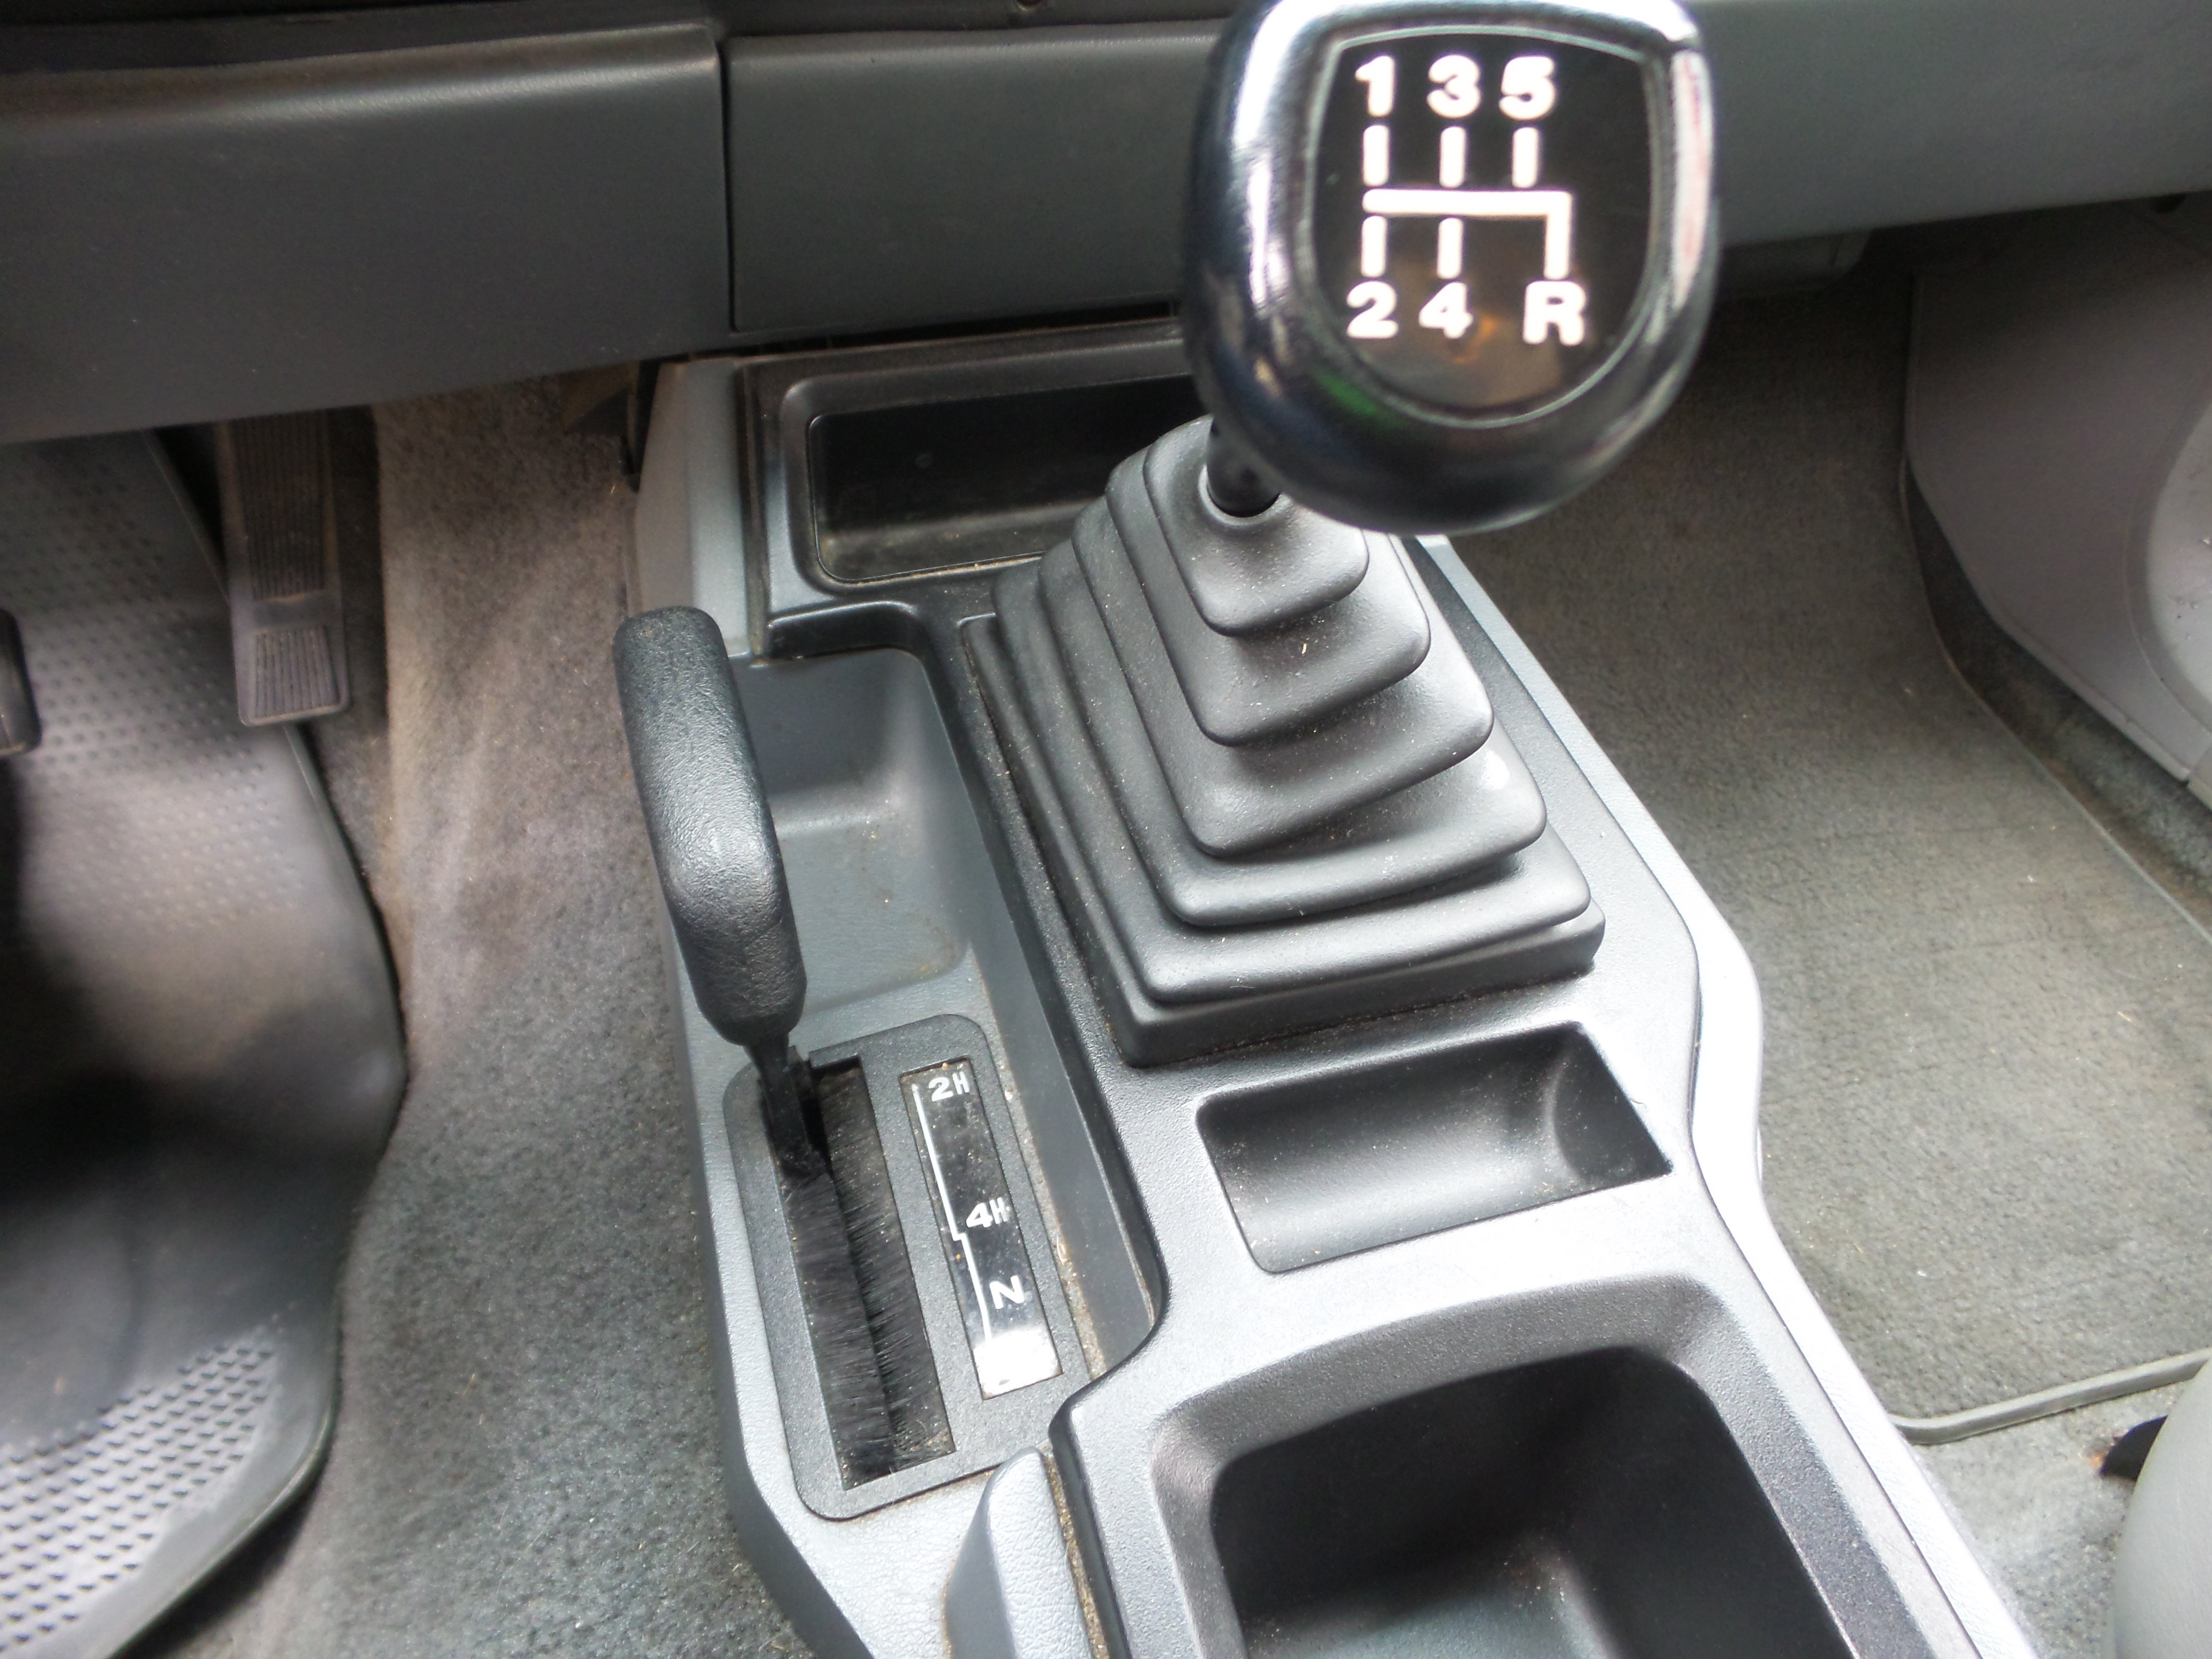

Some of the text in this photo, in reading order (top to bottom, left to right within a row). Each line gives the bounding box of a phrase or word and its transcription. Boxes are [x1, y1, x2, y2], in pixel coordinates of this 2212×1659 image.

[1355, 54, 1555, 120] 1 3 5
[1346, 280, 1586, 346] 2 4 R
[928, 1071, 970, 1101] 2H
[966, 1197, 1010, 1227] 4H
[989, 1275, 1025, 1309] N
